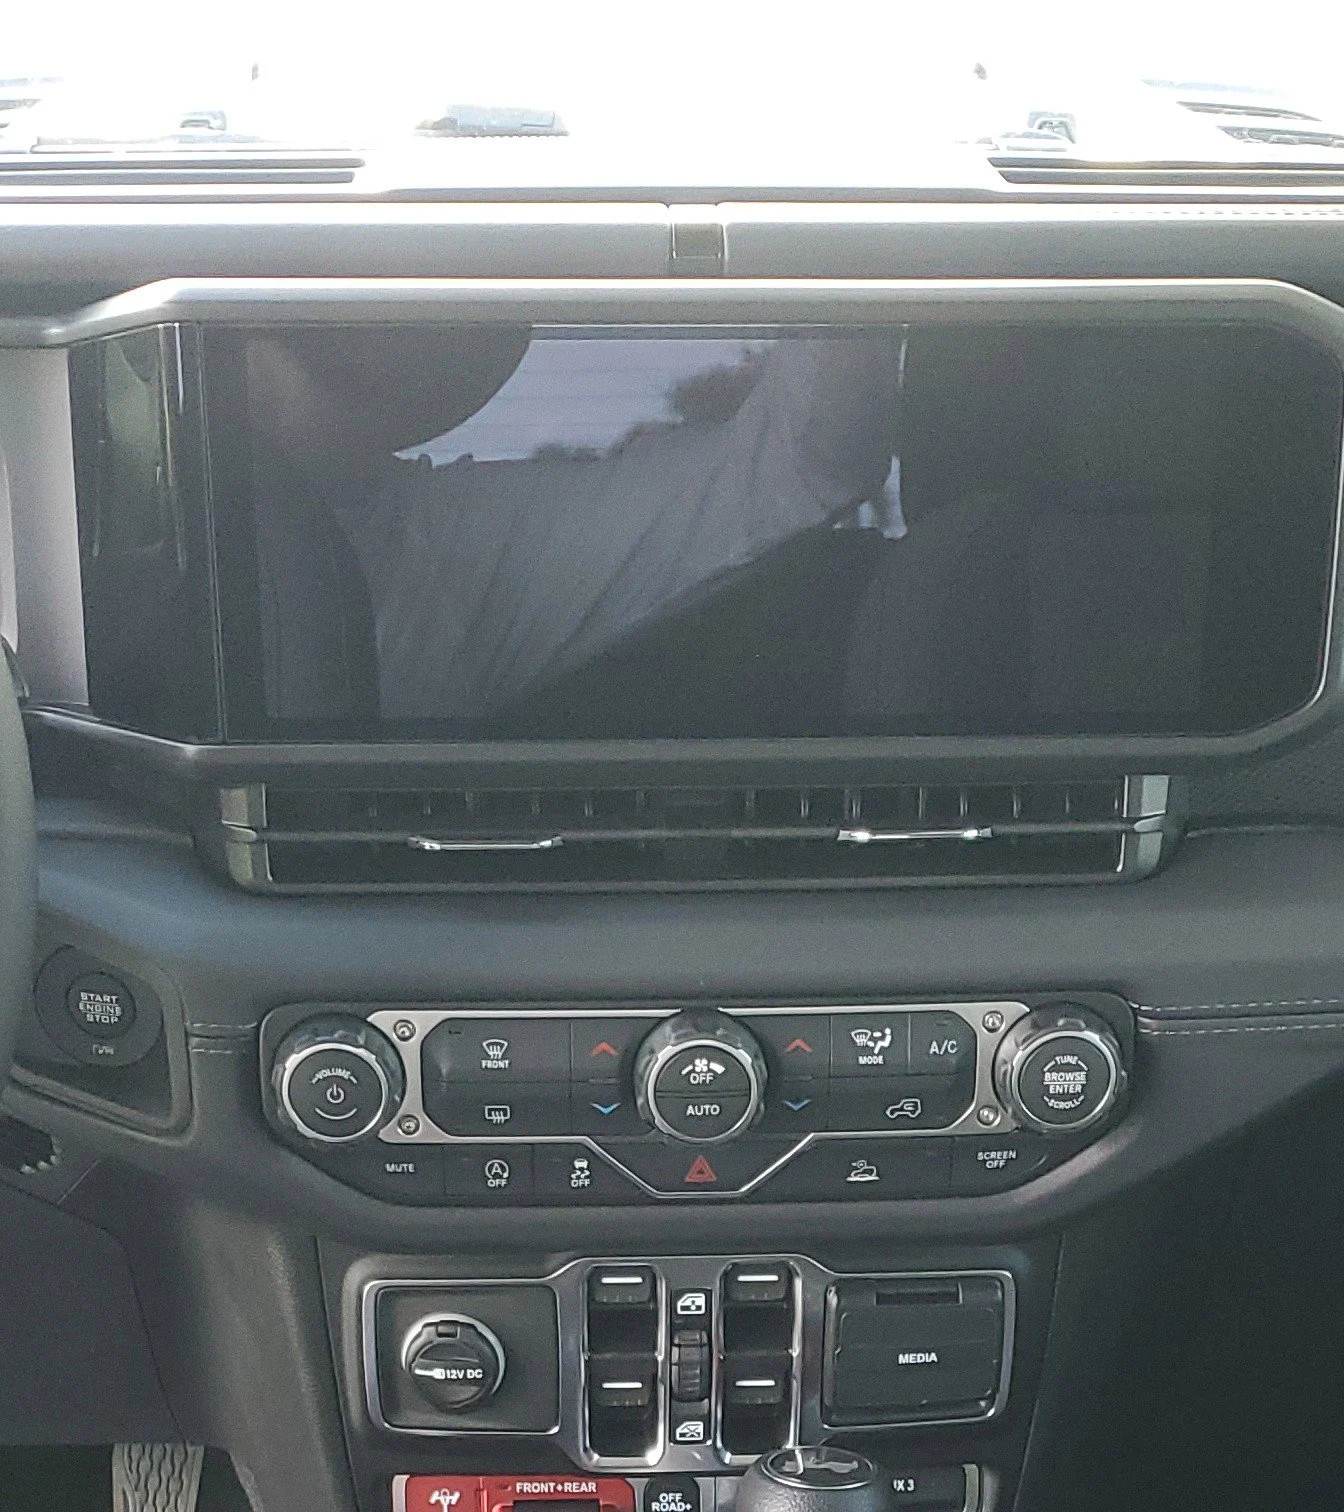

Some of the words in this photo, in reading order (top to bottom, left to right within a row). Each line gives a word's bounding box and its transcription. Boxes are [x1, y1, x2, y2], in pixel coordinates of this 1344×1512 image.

[80, 992, 118, 1003] START
[78, 1003, 122, 1016] ENGINE
[86, 1014, 119, 1024] STOP
[929, 1039, 959, 1055] A/C
[480, 1059, 510, 1070] FRONT
[858, 1055, 885, 1065] MODE
[1054, 1055, 1080, 1066] TUNE
[314, 1068, 353, 1081] VOLUME
[689, 1072, 715, 1085] OFF
[1043, 1071, 1087, 1082] BROWSE
[1048, 1083, 1083, 1094] ENTER
[685, 1104, 721, 1116] AUTO
[1048, 1098, 1081, 1111] SCROLL
[976, 1150, 1017, 1160] SCREEN
[385, 1162, 416, 1174] MUTE
[985, 1160, 1006, 1169] OFF
[487, 1177, 508, 1188] OFF
[570, 1177, 591, 1188] OFF
[898, 1352, 938, 1365] MEDIA
[446, 1369, 465, 1379] 12V
[466, 1369, 483, 1379] DC
[906, 1479, 916, 1492] 3
[659, 1492, 682, 1503] OFF
[651, 1502, 692, 1512] ROAD+
